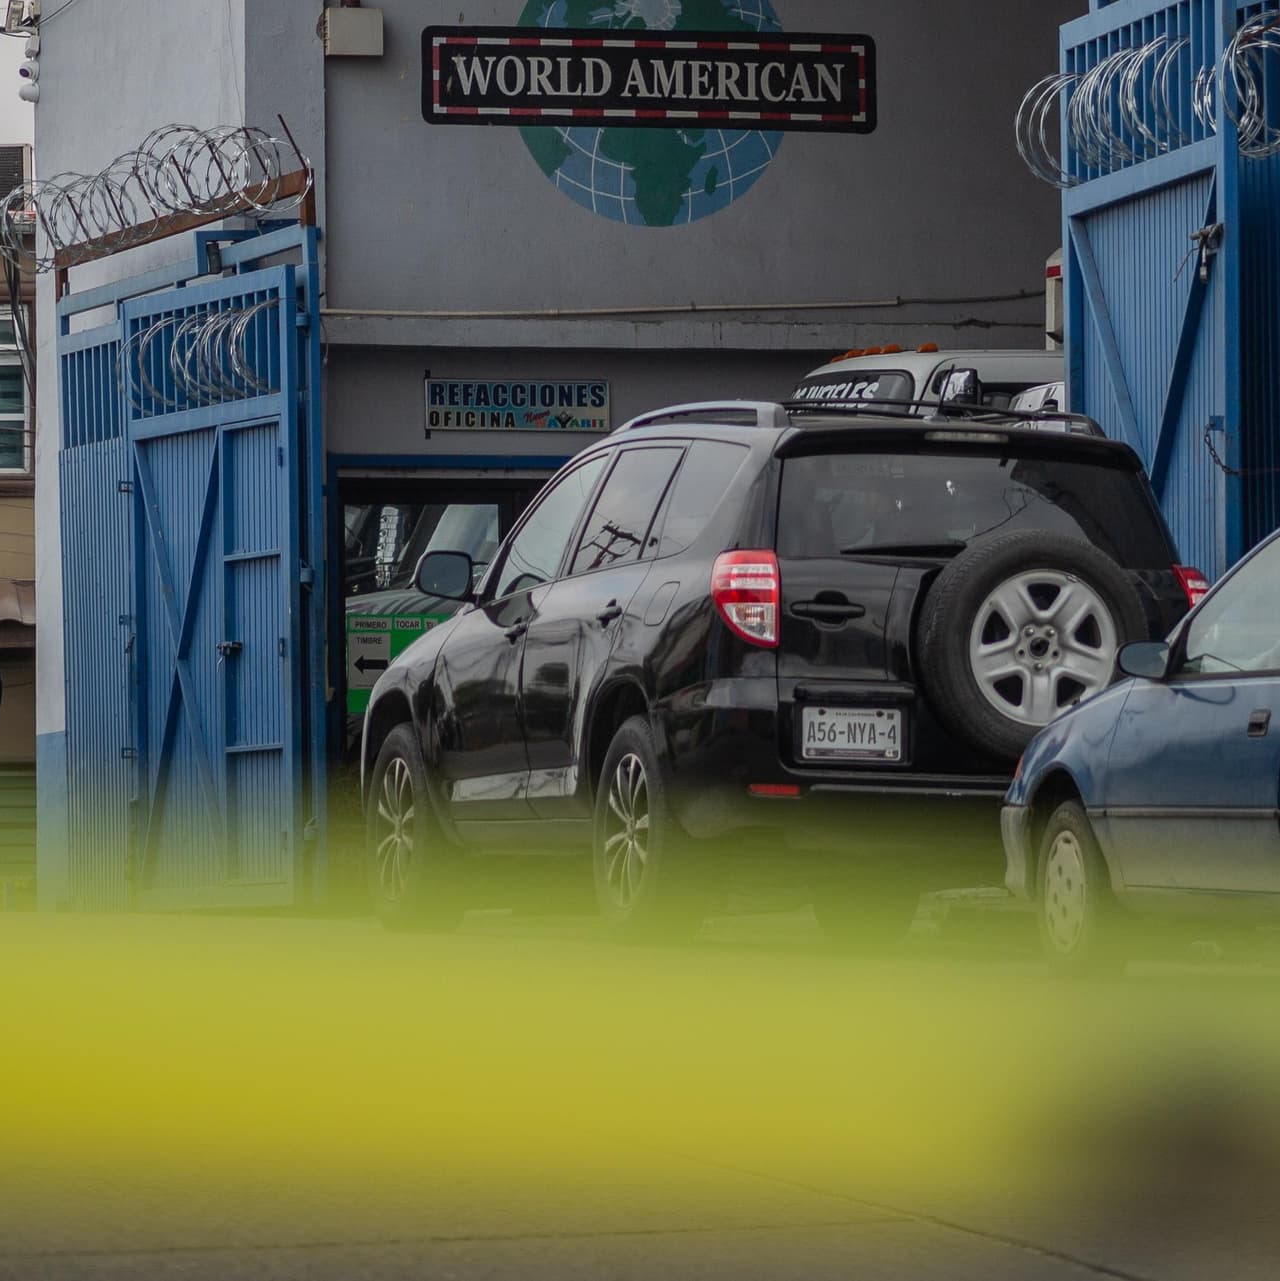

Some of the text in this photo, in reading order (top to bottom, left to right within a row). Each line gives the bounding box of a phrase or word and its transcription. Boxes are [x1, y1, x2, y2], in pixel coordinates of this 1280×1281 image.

[451, 54, 845, 103] WORLD AMERICAN
[430, 383, 605, 408] REFACCIONES
[429, 411, 515, 428] OFICINA
[354, 621, 387, 629] PRIMERO
[356, 637, 383, 645] TIMBRE
[807, 720, 897, 745] A56-NYA-4
